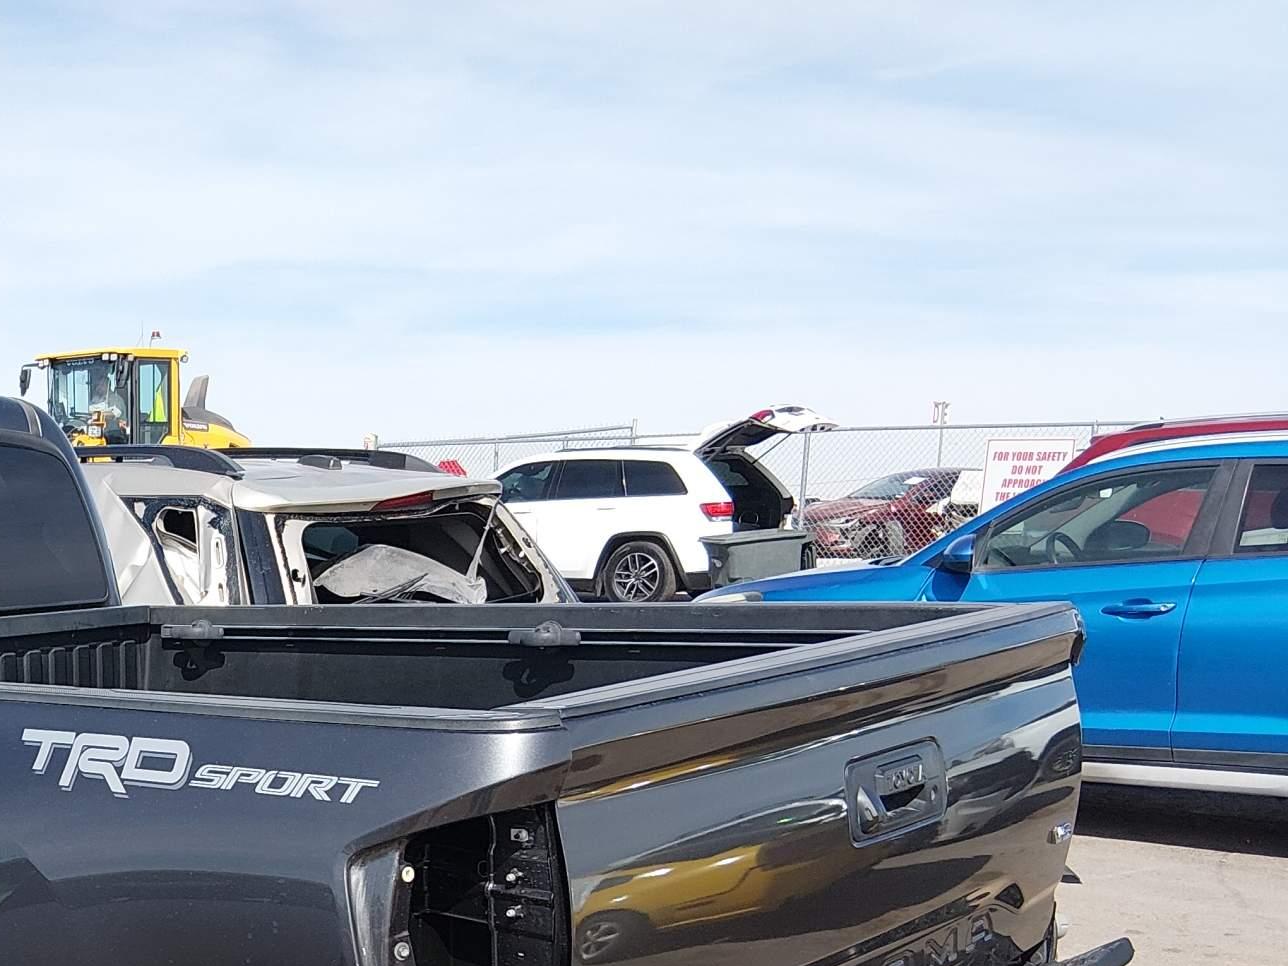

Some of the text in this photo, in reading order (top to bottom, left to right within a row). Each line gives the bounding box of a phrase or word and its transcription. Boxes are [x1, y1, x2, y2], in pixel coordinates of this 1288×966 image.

[992, 451, 1068, 461] FOR YOUR SAFETY
[1011, 465, 1044, 475] DO NOT
[1001, 478, 1046, 489] APPROAC
[21, 728, 381, 805] TRD SPORT
